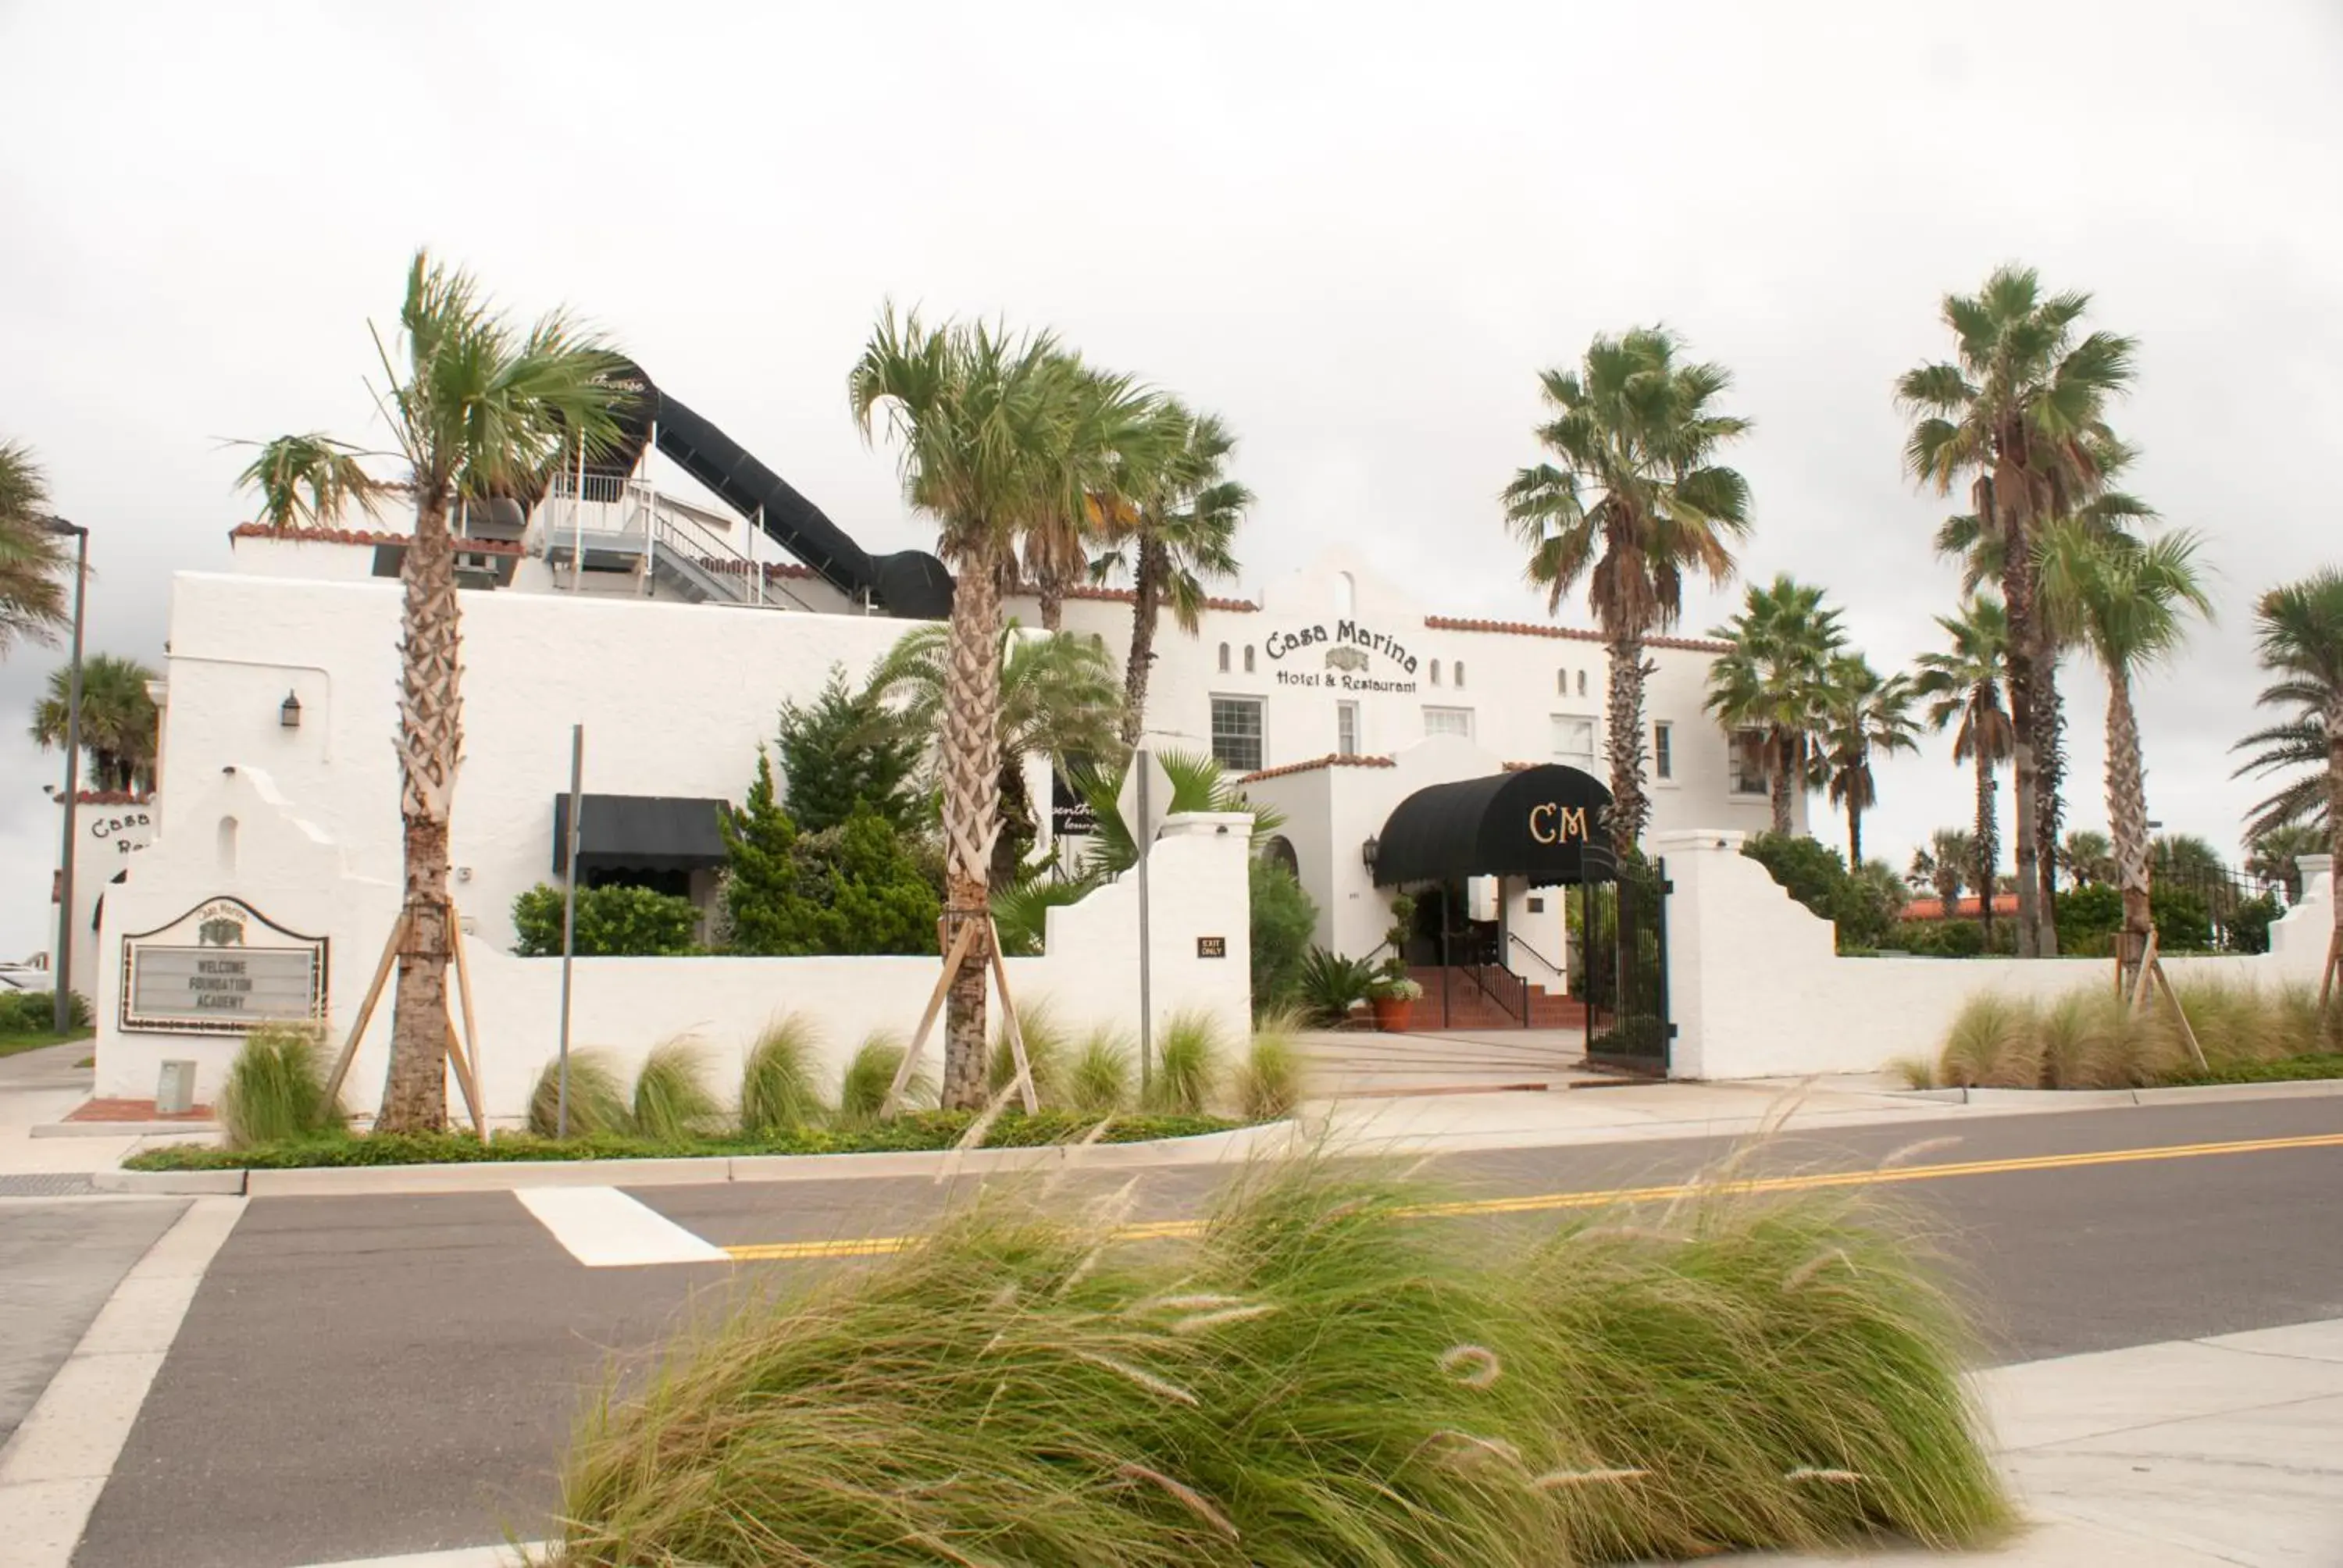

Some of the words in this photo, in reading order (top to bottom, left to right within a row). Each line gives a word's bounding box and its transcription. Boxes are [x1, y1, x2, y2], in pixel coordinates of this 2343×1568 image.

[1266, 625, 1328, 660] Casa
[1336, 619, 1418, 675] Marina
[1276, 670, 1320, 686] Hotel
[1325, 673, 1336, 687] &
[1341, 674, 1417, 693] Restaurant
[91, 814, 151, 838] Casa
[1529, 802, 1589, 843] CM
[198, 960, 247, 975] WELCOME
[197, 994, 245, 1010] ACADEMY
